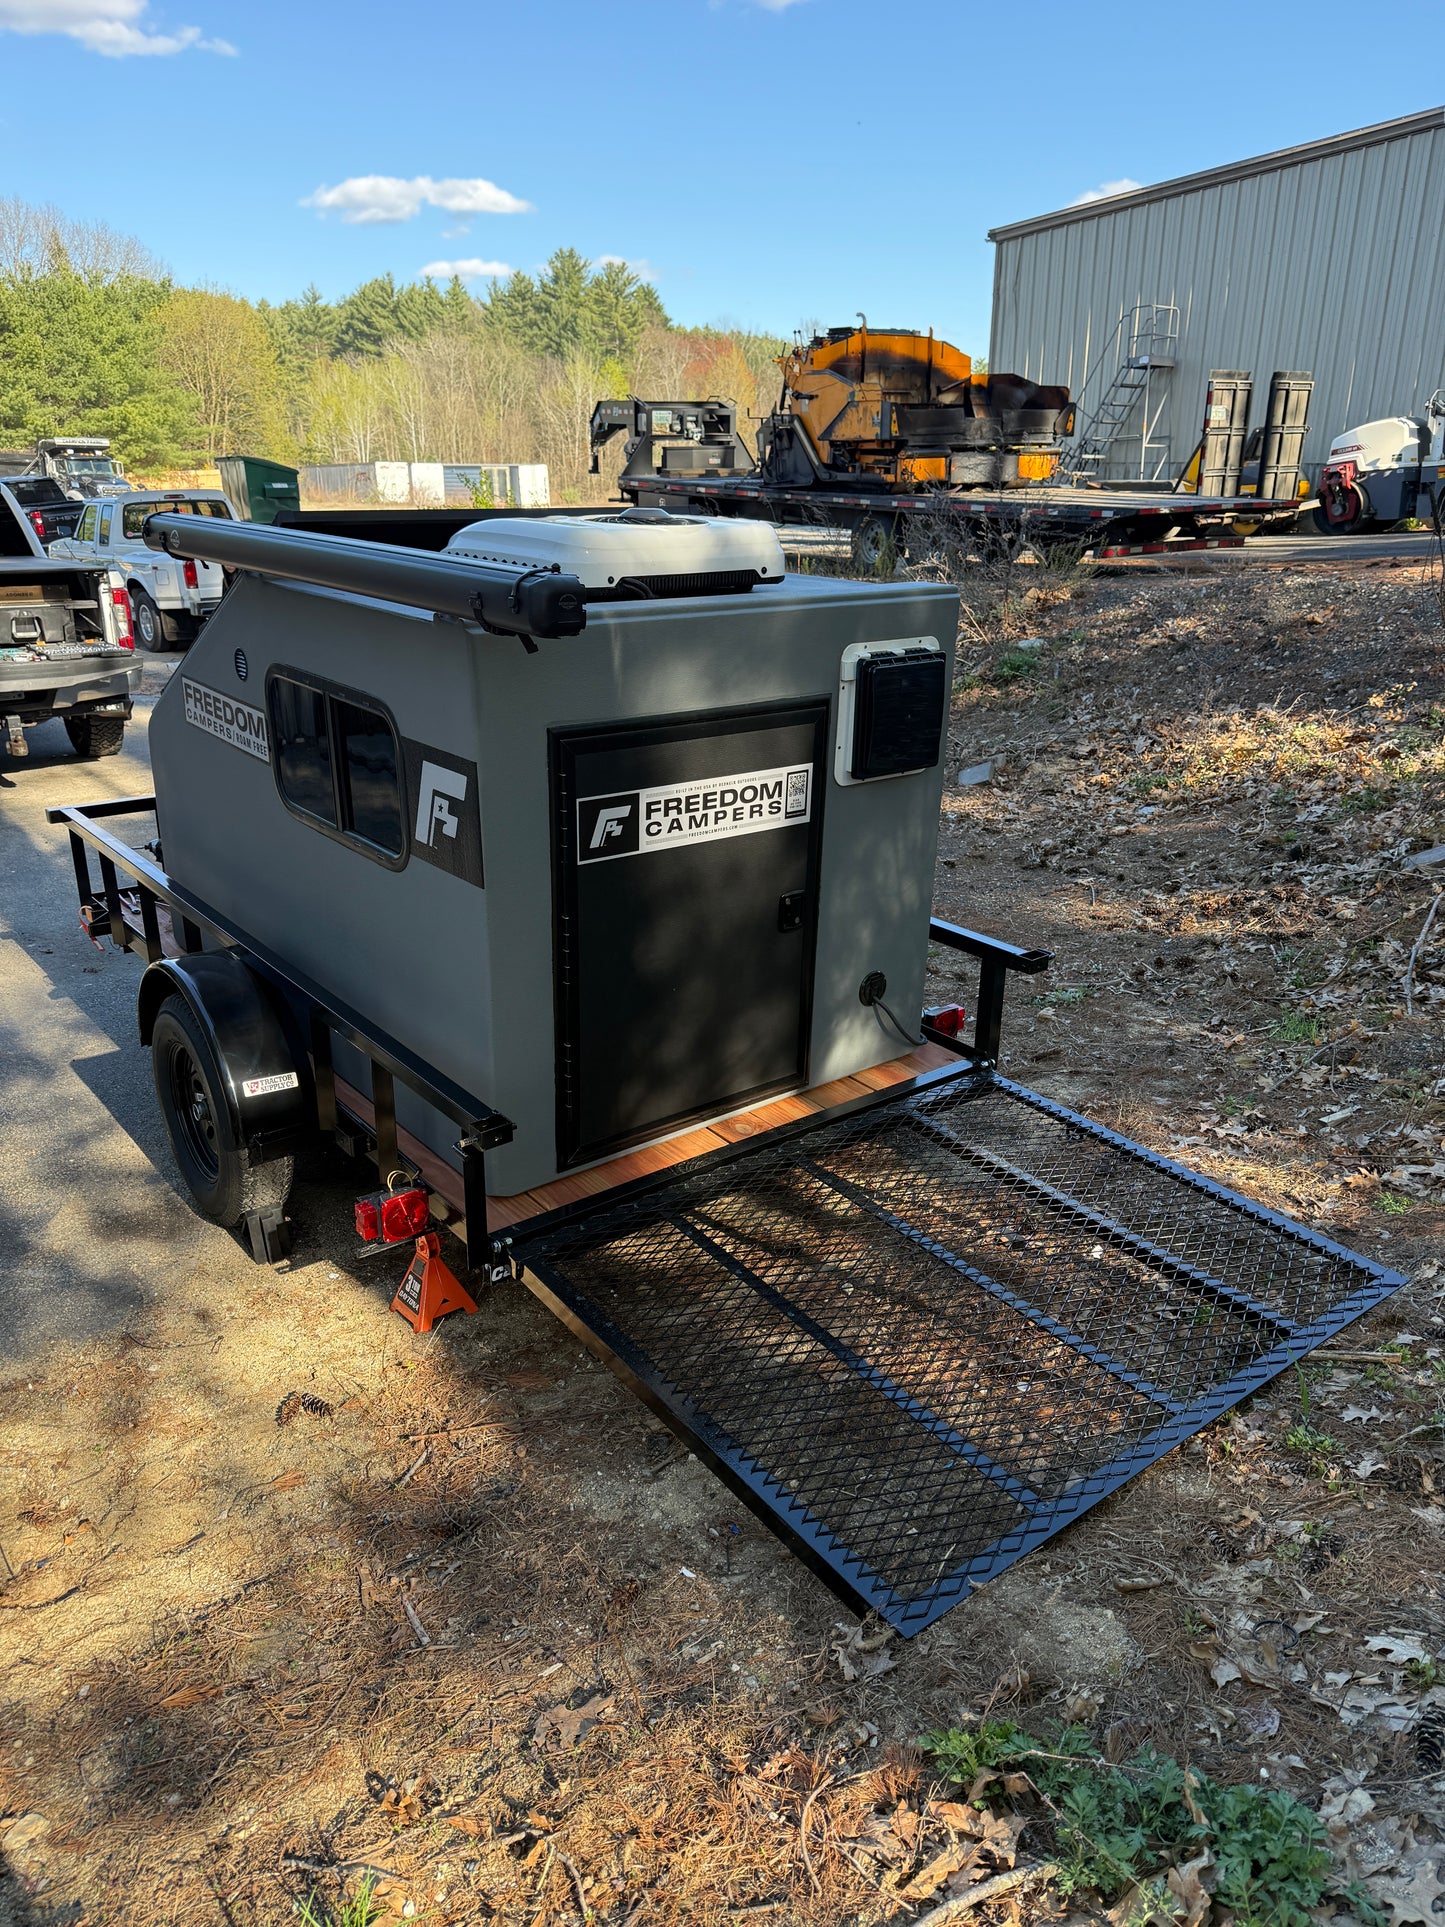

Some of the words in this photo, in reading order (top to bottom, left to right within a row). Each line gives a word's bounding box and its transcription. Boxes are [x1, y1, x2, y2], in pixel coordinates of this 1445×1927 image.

[184, 682, 266, 741] FREEDOM
[253, 741, 267, 756] FREE
[646, 781, 783, 820] FREEDOM
[646, 800, 782, 837] CAMPERS
[260, 1074, 293, 1086] TRACTOR
[398, 1289, 420, 1311] DAYTONA
